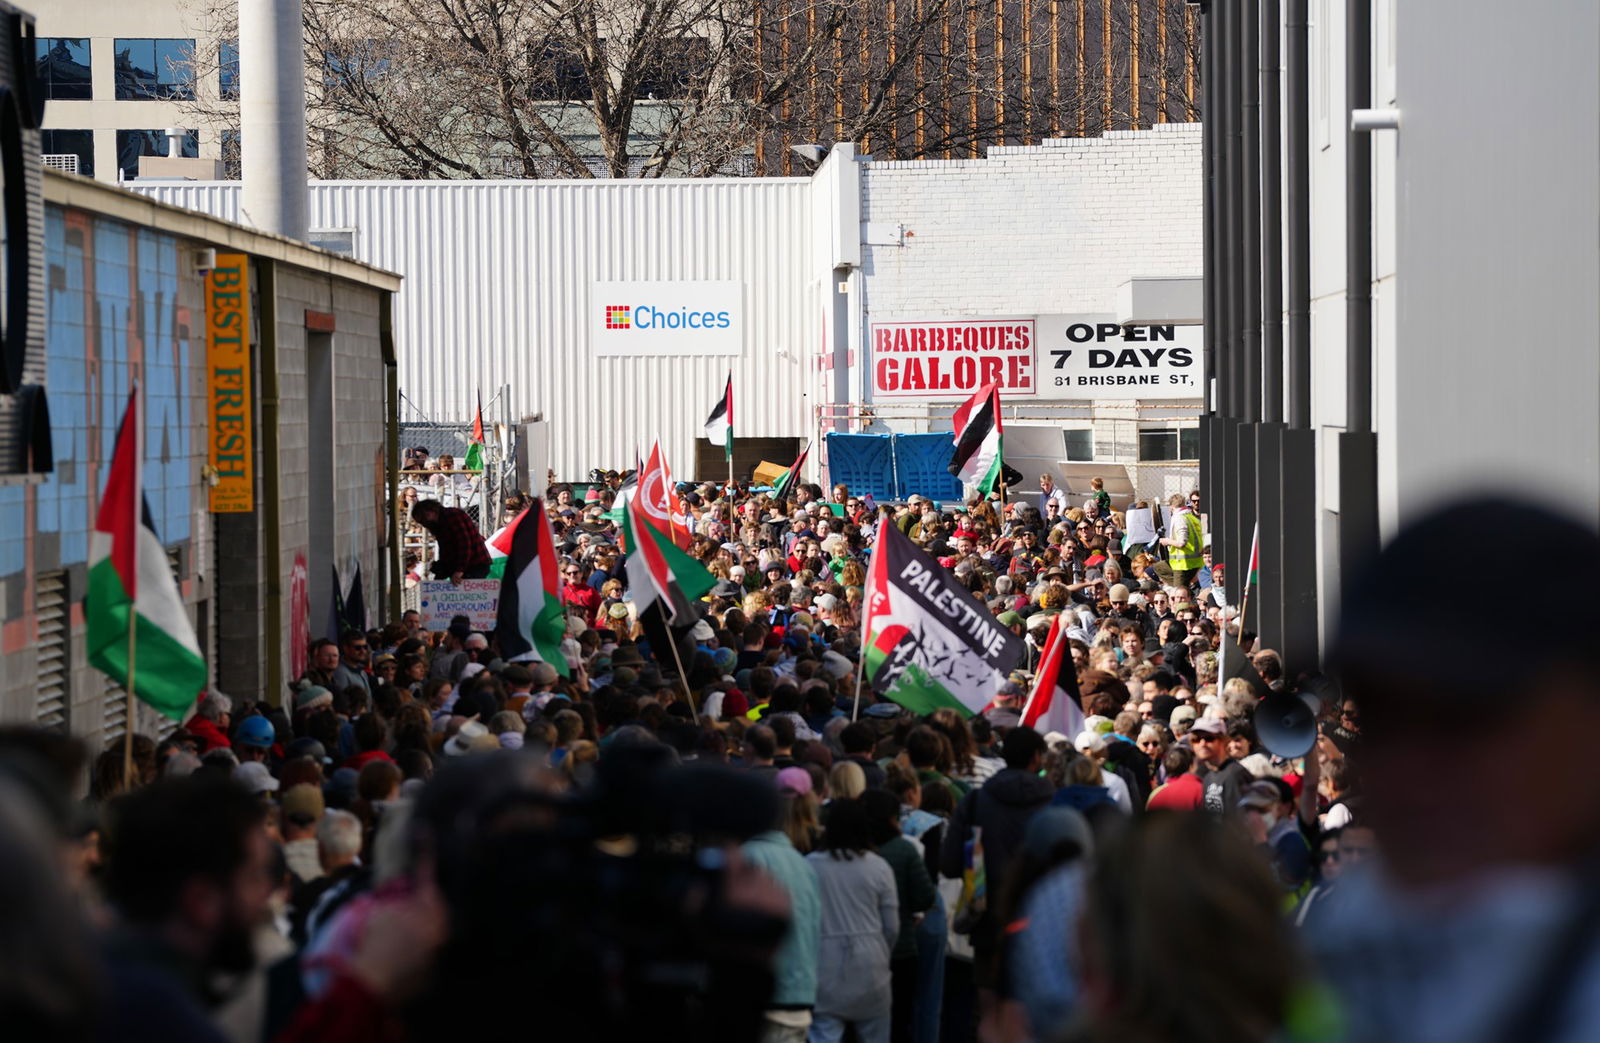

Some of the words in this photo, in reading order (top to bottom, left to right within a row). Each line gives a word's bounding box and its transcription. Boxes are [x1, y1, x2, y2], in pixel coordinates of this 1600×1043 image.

[211, 263, 243, 354] BEST
[634, 305, 731, 329] Choices
[875, 325, 1030, 353] BARBEQUES
[1065, 322, 1175, 343] OPEN
[1050, 349, 1073, 369] 7
[1088, 347, 1194, 369] DAYS
[876, 355, 1031, 391] GALORE
[1054, 376, 1071, 387] 81
[1078, 374, 1160, 387] BRISBANE
[1169, 374, 1195, 387] ST,
[213, 364, 246, 480] FRESH
[431, 593, 438, 602] A
[463, 580, 499, 592] BOMBED
[436, 598, 497, 612] PLAYGROUND!
[900, 559, 1006, 658] PALESTINE
